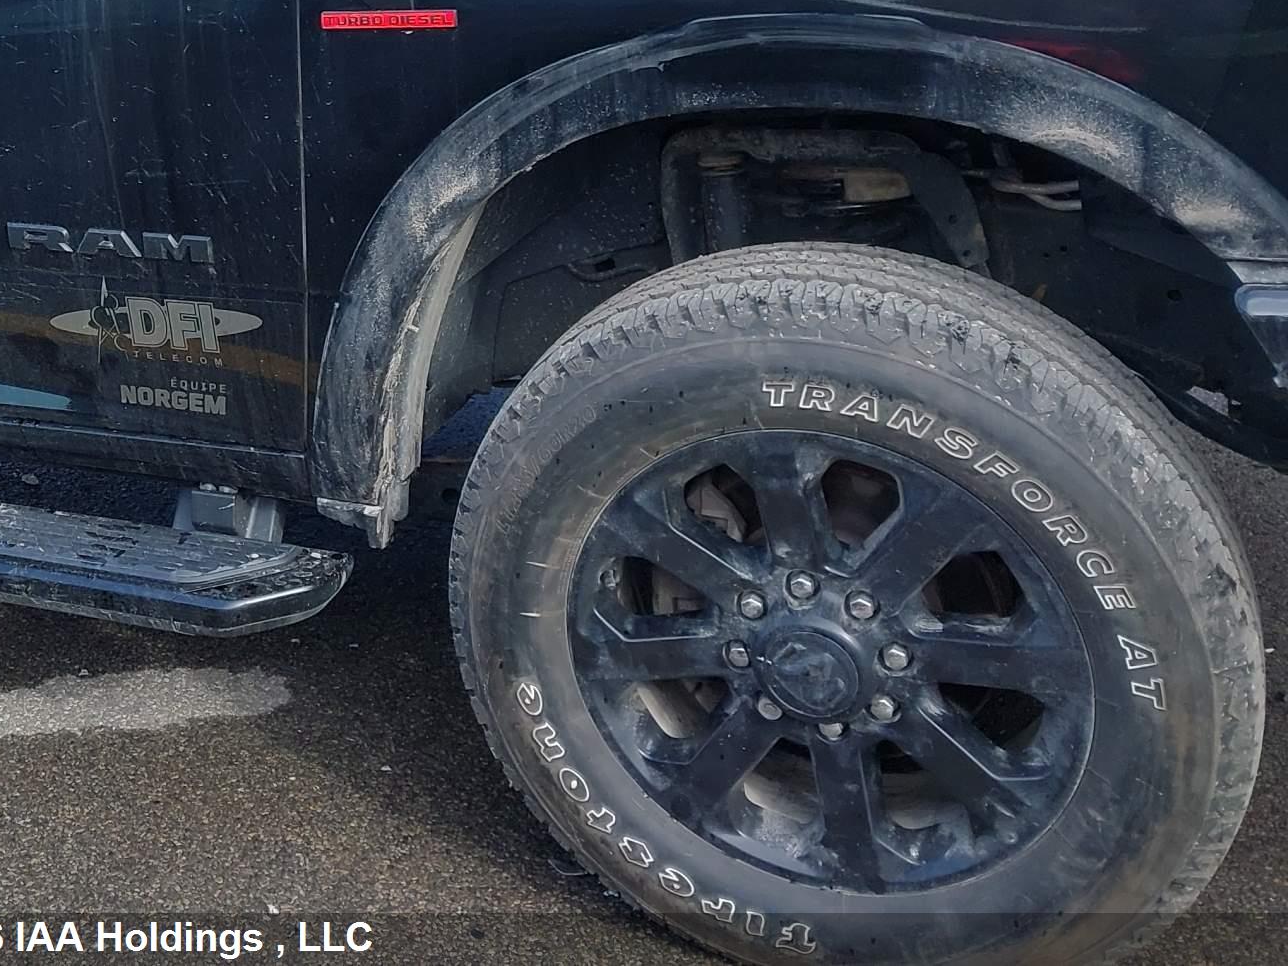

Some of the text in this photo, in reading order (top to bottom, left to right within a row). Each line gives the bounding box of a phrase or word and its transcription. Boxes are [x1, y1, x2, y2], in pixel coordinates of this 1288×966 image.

[323, 14, 454, 27] TURBO DIESEL
[7, 221, 215, 264] RAM
[124, 295, 221, 354] DFI
[119, 384, 227, 416] NORGEM
[761, 380, 1167, 712] TRANSFORCE AT
[516, 682, 816, 954] Firestone
